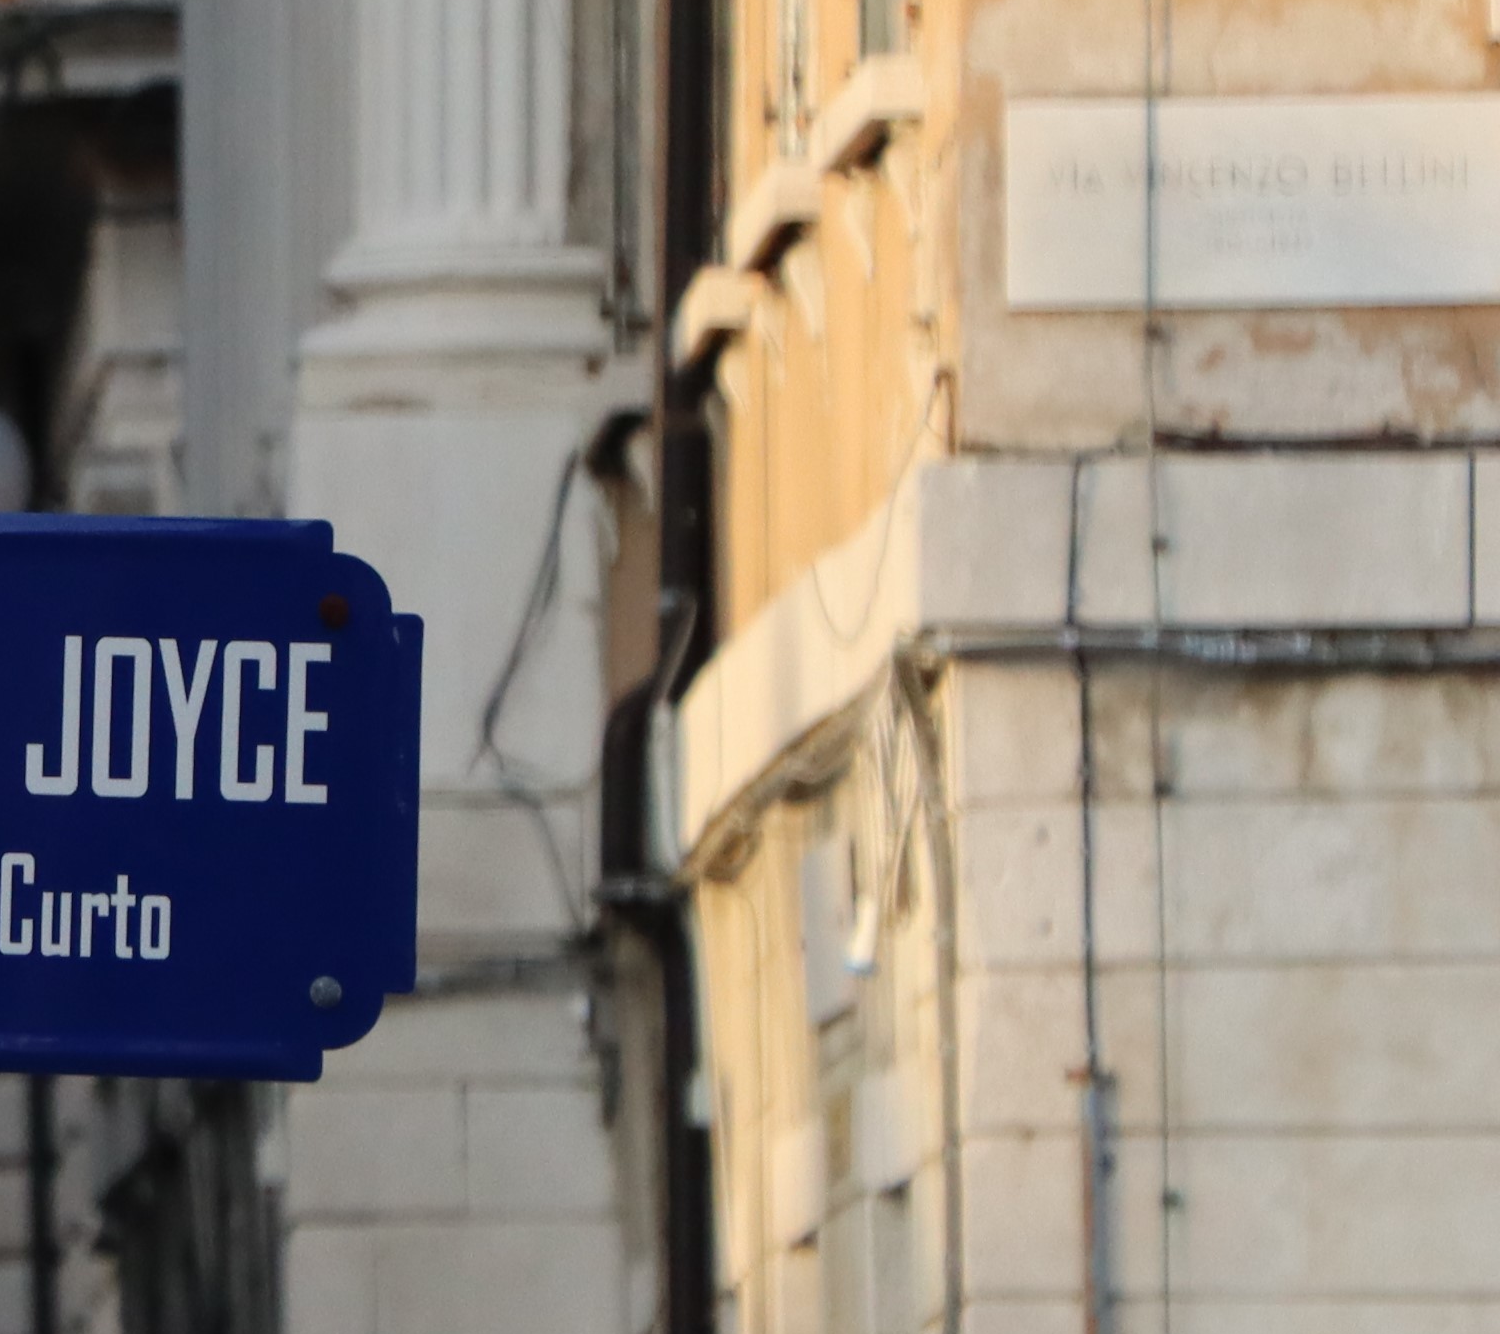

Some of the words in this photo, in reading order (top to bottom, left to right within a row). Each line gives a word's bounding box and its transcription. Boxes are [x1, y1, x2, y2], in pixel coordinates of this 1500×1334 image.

[1123, 153, 1309, 198] VNCENZO
[25, 635, 331, 804] JOYCE
[0, 852, 171, 959] Curto
